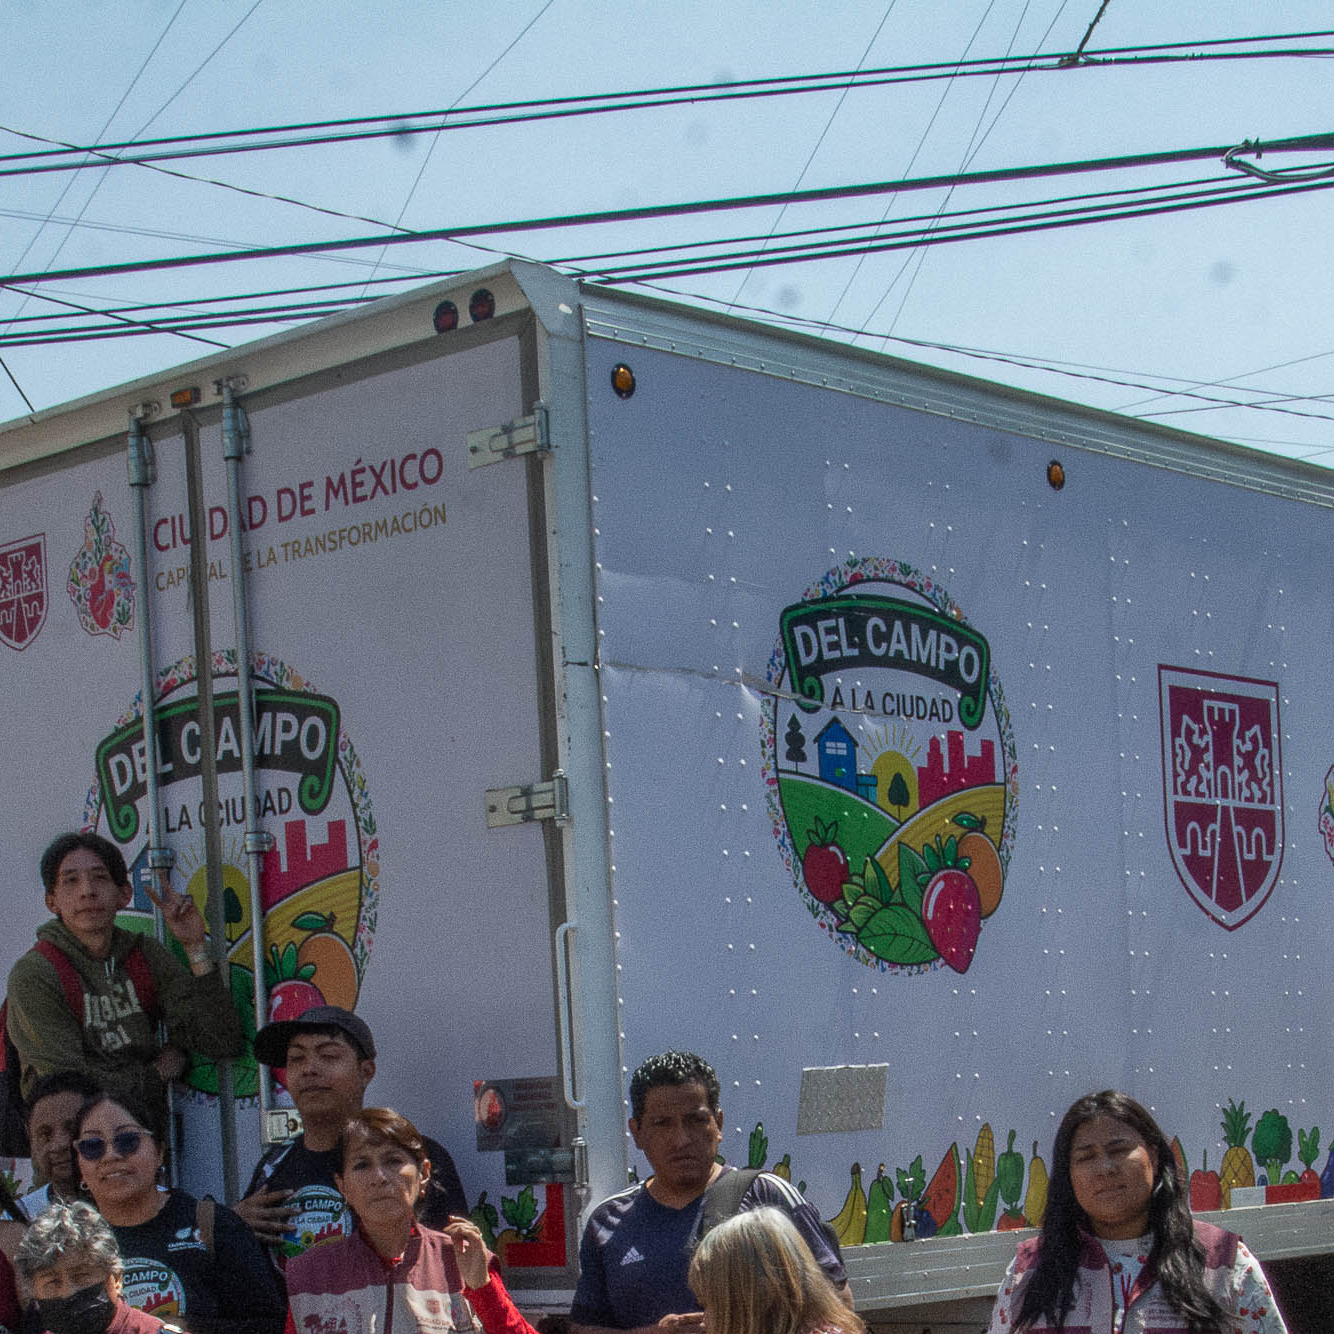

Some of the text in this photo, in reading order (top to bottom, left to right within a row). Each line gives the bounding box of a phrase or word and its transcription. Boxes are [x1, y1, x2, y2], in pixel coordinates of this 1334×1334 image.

[276, 481, 316, 523] DE
[324, 448, 444, 511] MÉXICO
[155, 560, 227, 592] CAPAL
[257, 547, 277, 569] LA
[280, 503, 447, 563] TRANSFORMACIÓN
[793, 616, 980, 684] DEL CAMPO
[831, 686, 954, 723] A LA CIUDAD
[108, 711, 326, 796] DEL CAMPO
[165, 804, 193, 833] LA
[305, 1199, 343, 1211] CAMPO
[123, 1270, 168, 1285] CAMPO
